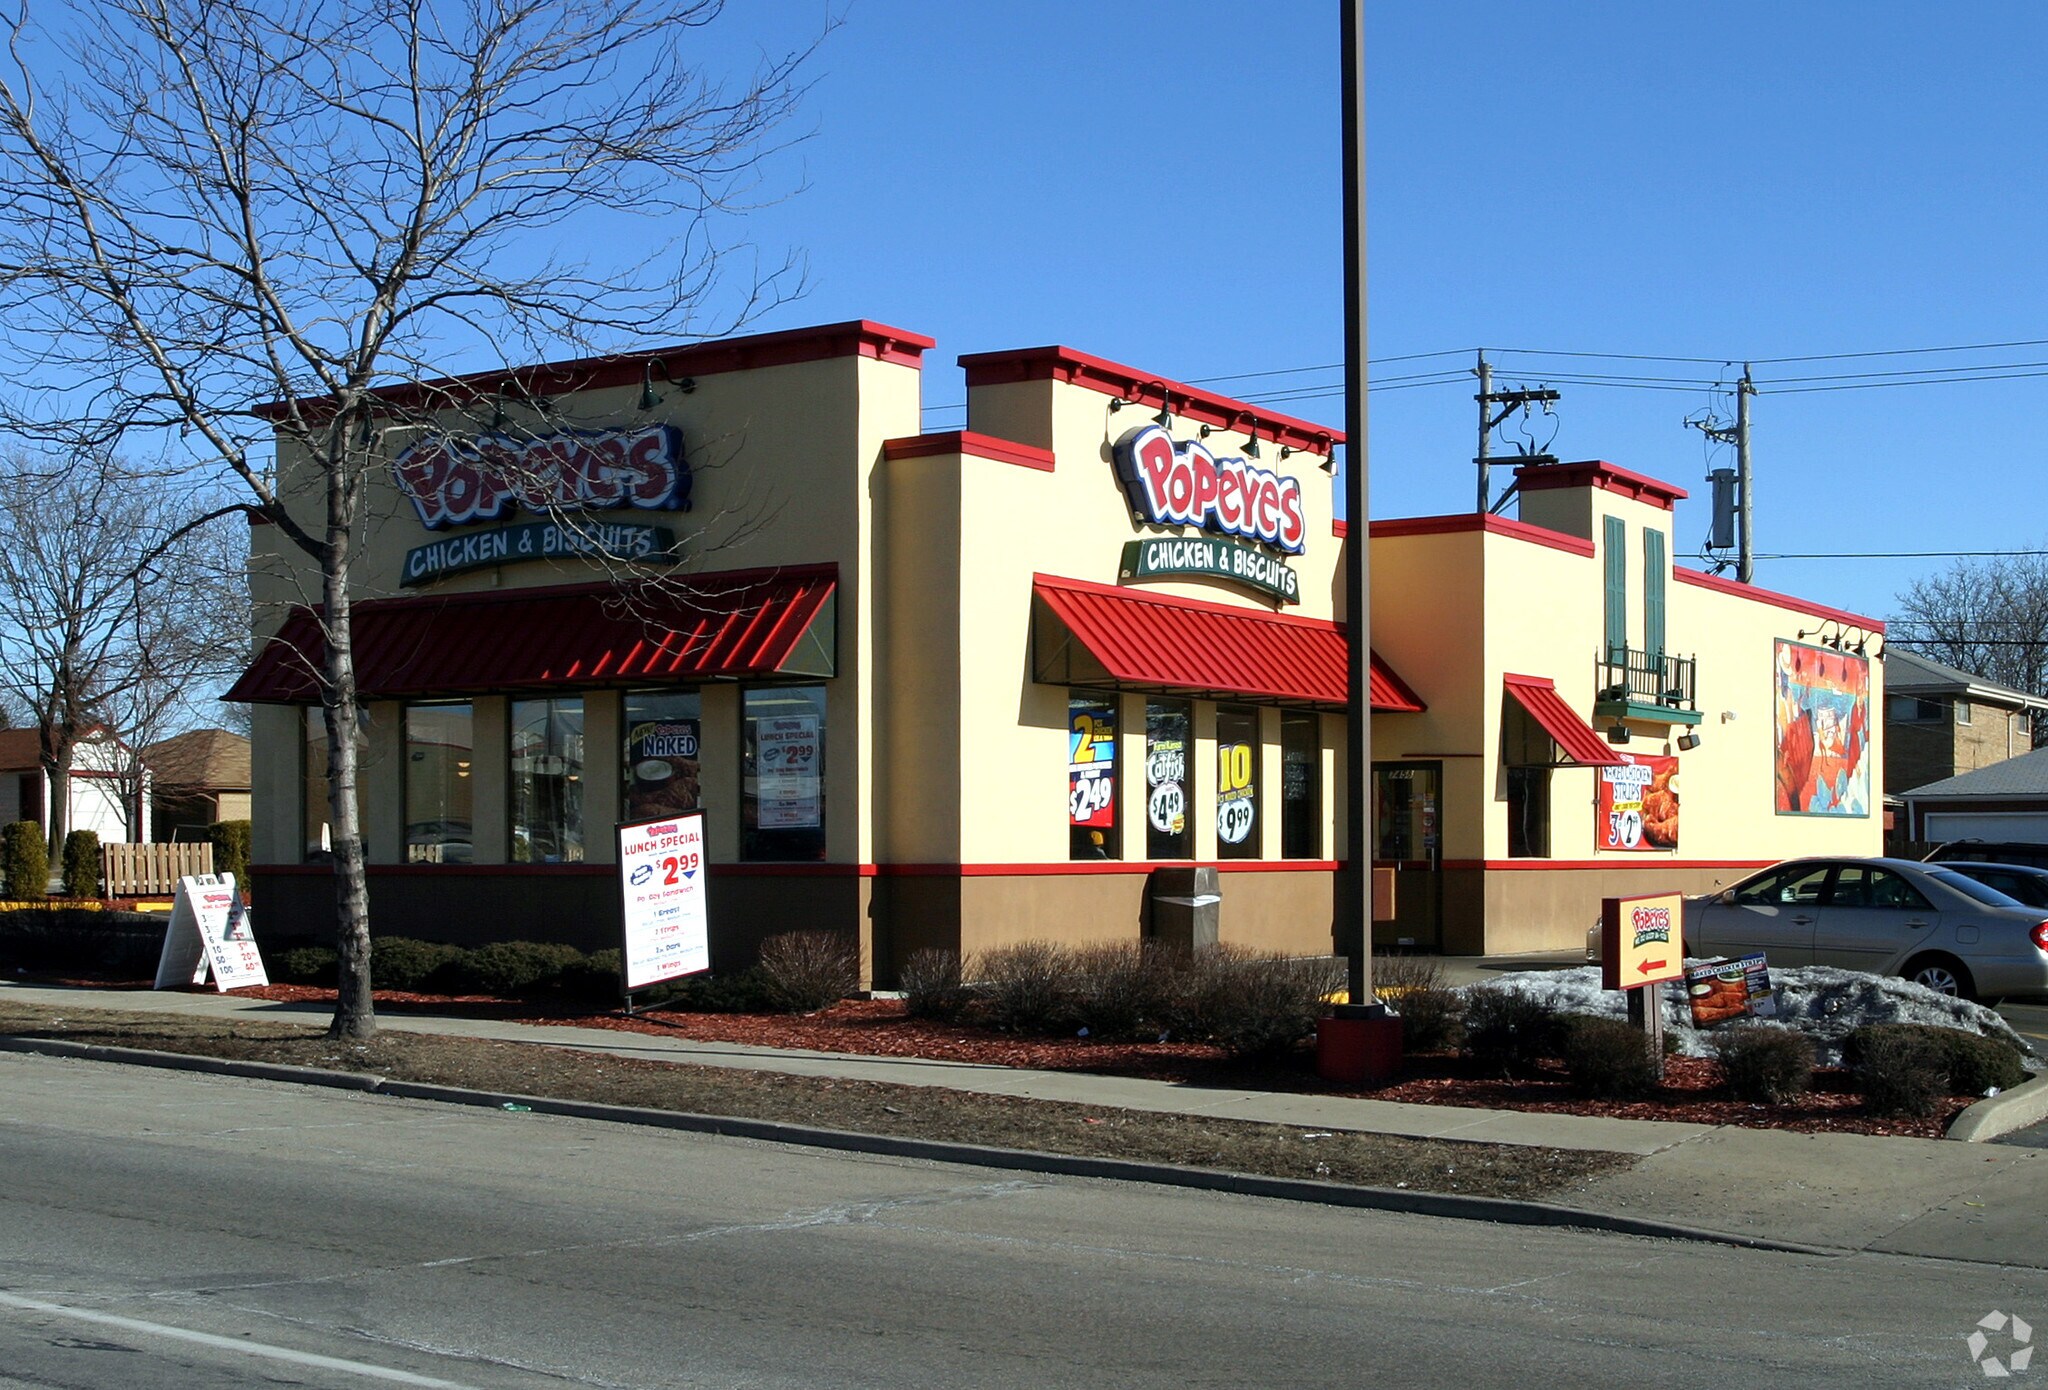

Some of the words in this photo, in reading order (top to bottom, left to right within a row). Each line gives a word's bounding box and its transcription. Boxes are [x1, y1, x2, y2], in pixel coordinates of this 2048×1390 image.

[1140, 436, 1302, 542] Popeyes
[410, 533, 509, 577] CHICKEN
[518, 531, 534, 554] &
[542, 525, 651, 556] BISCUITS
[1147, 541, 1214, 571] CHICKEN
[1218, 546, 1230, 571] &
[1233, 549, 1296, 595] BISCUITS
[643, 735, 698, 756] NAKED
[1073, 714, 1095, 764] 2
[1148, 751, 1185, 787] Catfish
[1220, 743, 1251, 793] 10
[625, 839, 657, 856] LUNCH
[661, 832, 700, 849] SPECIAL
